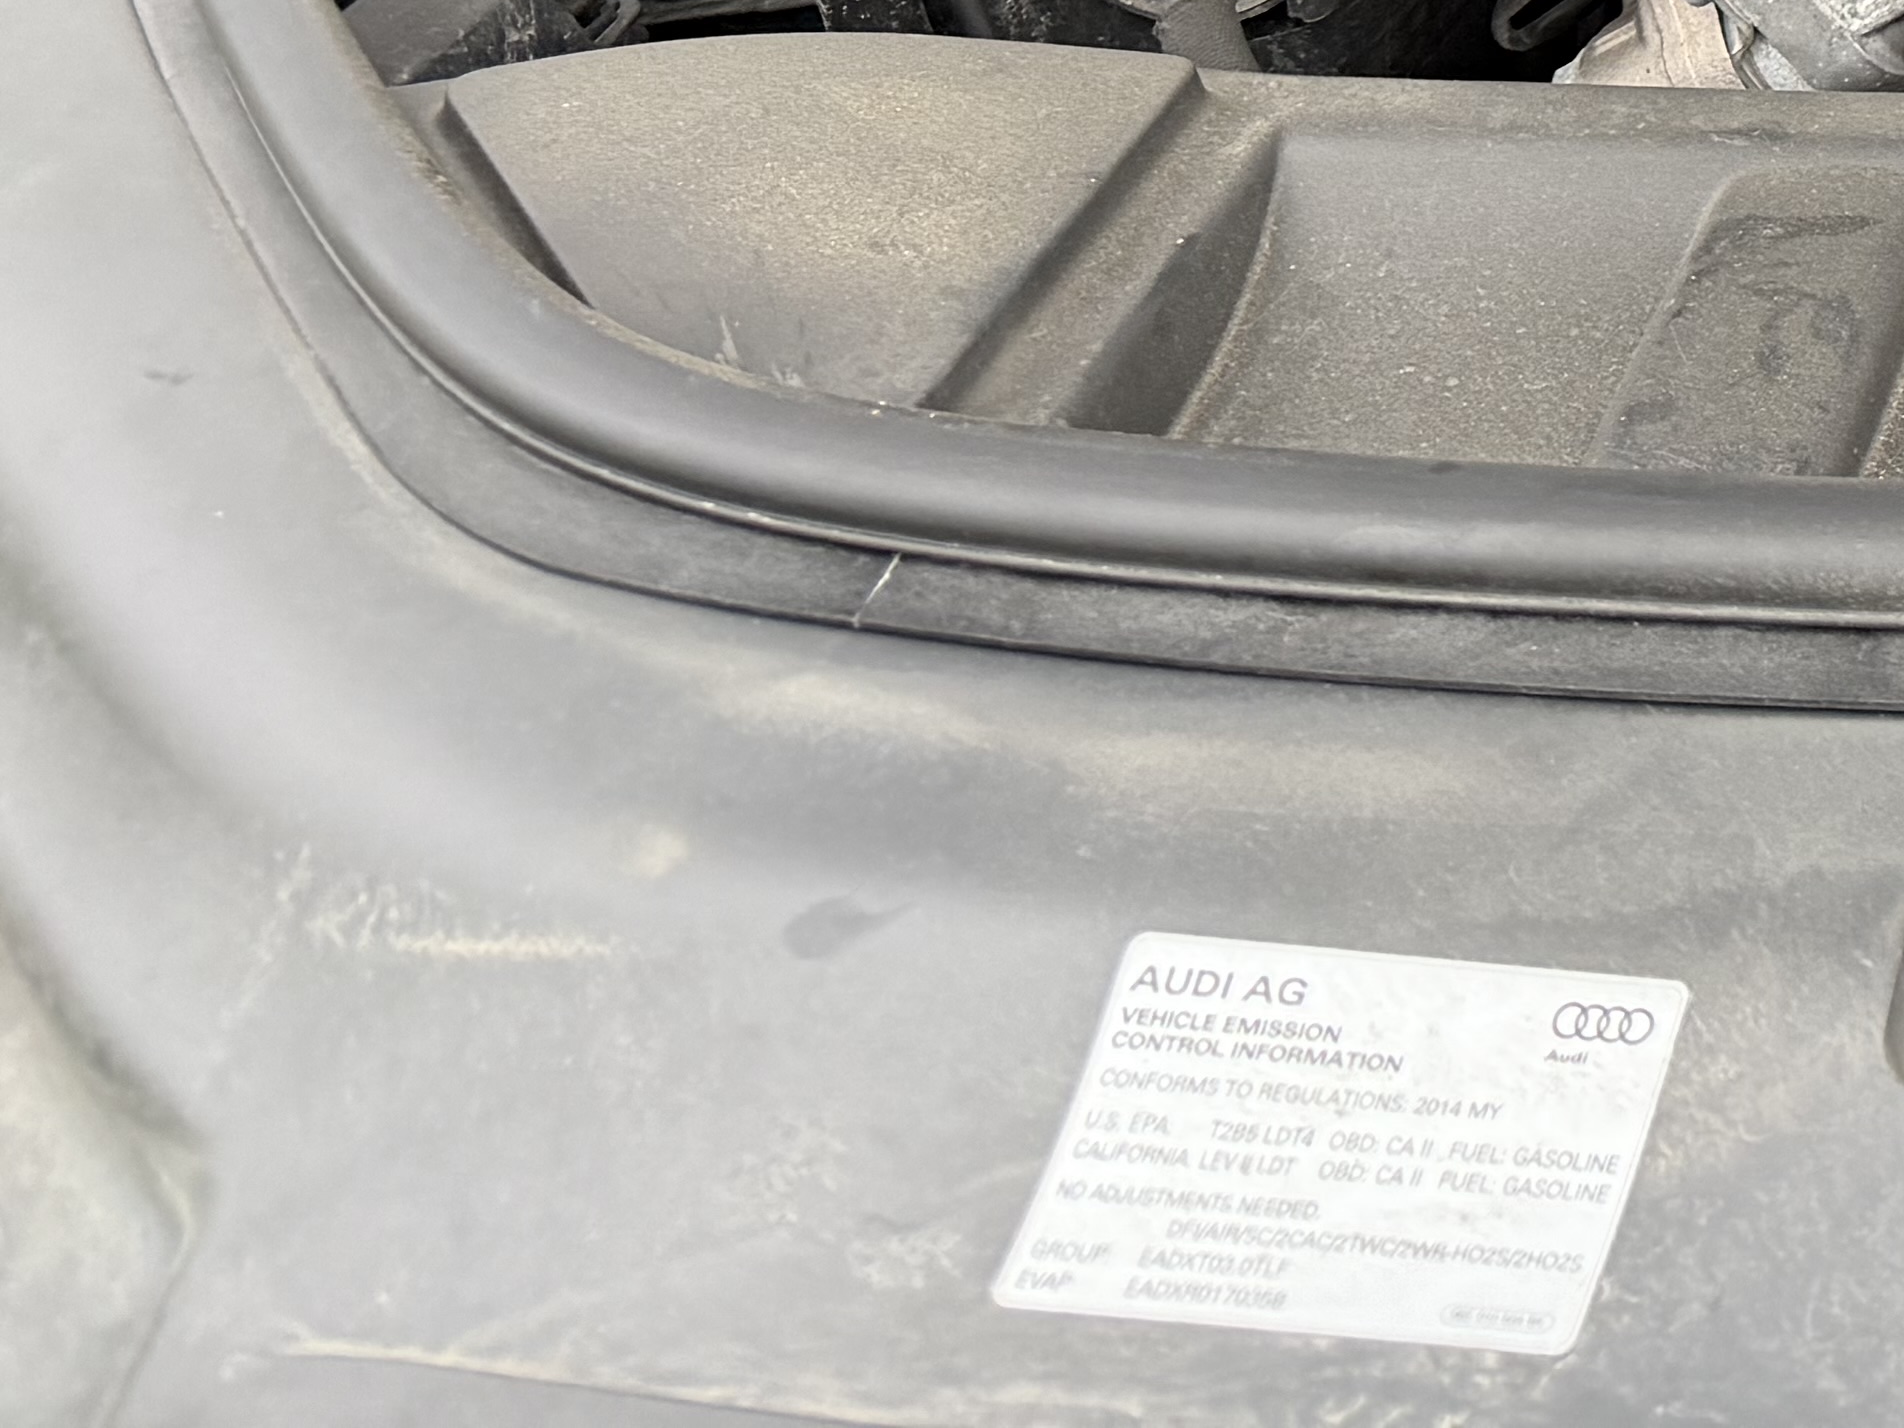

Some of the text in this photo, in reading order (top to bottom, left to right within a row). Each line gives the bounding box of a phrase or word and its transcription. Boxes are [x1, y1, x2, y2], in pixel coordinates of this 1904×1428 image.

[1129, 964, 1309, 1006] AUDI AG
[1121, 1006, 1344, 1044] VEHICLE EMISSION
[1111, 1030, 1405, 1074] CONTROL INFORMATION
[1543, 1048, 1589, 1065] Audi
[1099, 1066, 1504, 1120] CONFORMS TO REGULATIONS: 2014 MY
[1261, 1124, 1318, 1148] LDT4
[1328, 1130, 1381, 1157] OBD:
[1385, 1134, 1415, 1158] CA
[1448, 1140, 1507, 1165] FUEL:
[1512, 1145, 1622, 1176] GASOLINE
[1197, 1148, 1239, 1172] LEV
[1255, 1154, 1300, 1178] LDT
[1317, 1157, 1369, 1184] OBD:
[1375, 1164, 1405, 1187] CA
[1437, 1168, 1498, 1196] FUEL:
[1502, 1175, 1613, 1206] GASOLINE
[1055, 1178, 1323, 1222] NO ADJUSTMENTS NEEDED.
